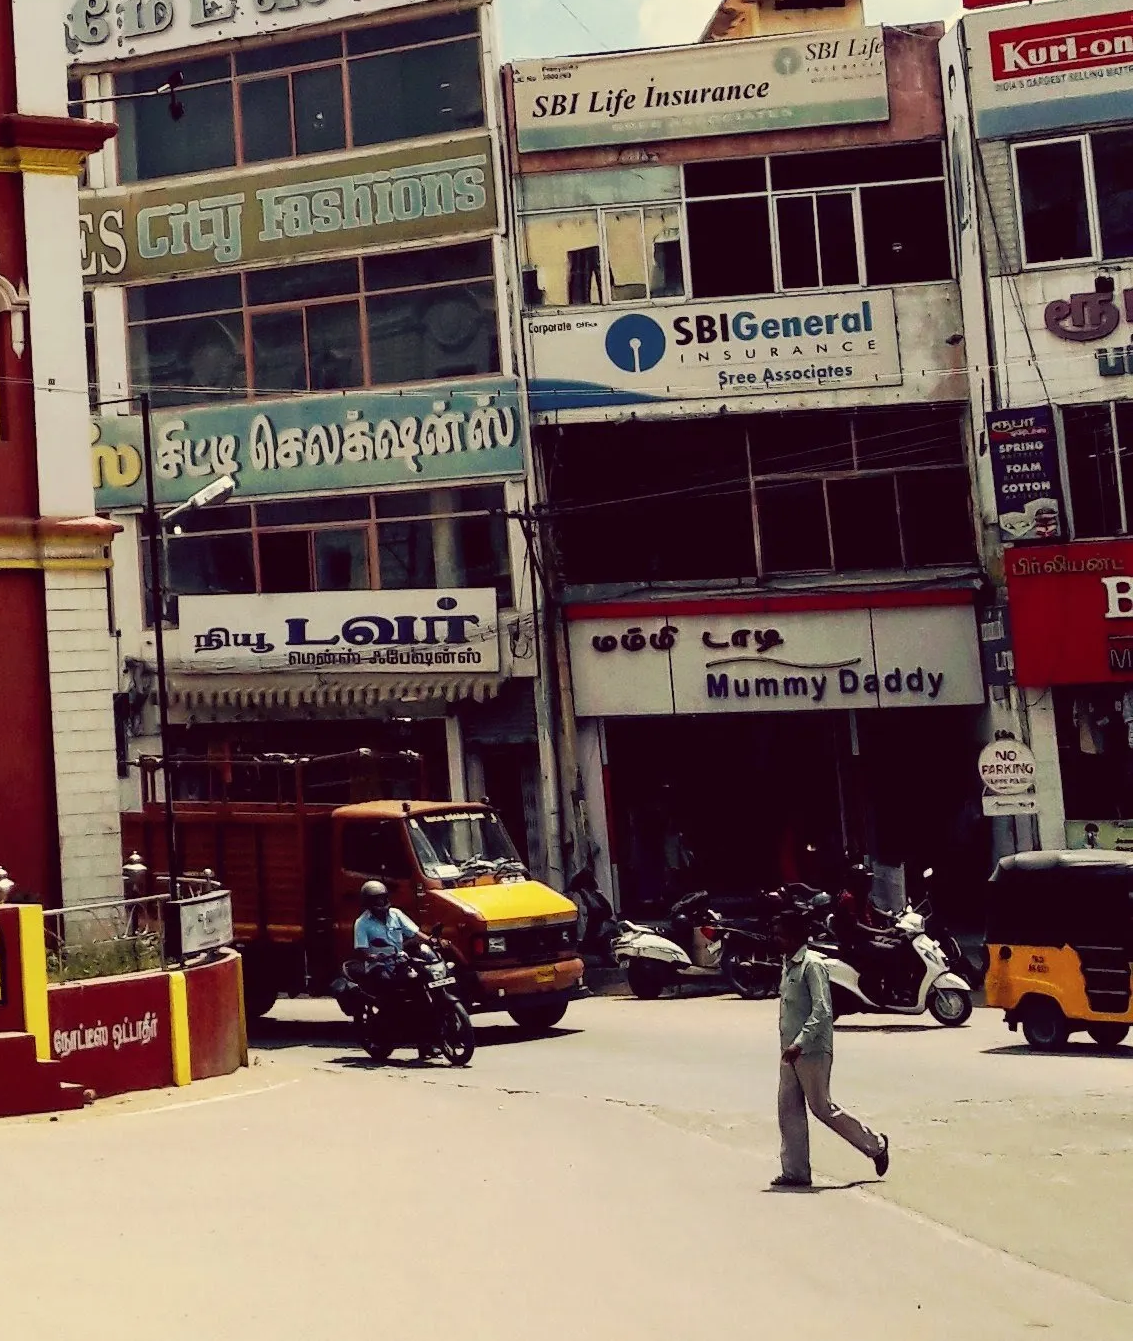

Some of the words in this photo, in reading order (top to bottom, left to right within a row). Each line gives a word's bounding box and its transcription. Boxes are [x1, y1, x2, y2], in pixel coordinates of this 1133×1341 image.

[806, 41, 840, 60] SBI
[847, 37, 883, 61] Life
[999, 33, 1133, 73] Kurl-on
[532, 93, 580, 118] SBI
[588, 87, 637, 118] Life
[136, 194, 245, 262] City
[255, 154, 487, 242] Fashions
[680, 340, 877, 364] INSURANCE
[718, 370, 757, 386] Sree
[763, 364, 854, 383] Associates
[999, 441, 1044, 454] SPRING
[1006, 462, 1042, 474] FOAM
[1002, 481, 1051, 493] COTTON
[193, 628, 276, 654] நியூ
[285, 596, 480, 646] டவர்
[592, 625, 679, 653] மம்மி
[702, 626, 783, 652] டாடி
[707, 673, 827, 701] Mummy
[839, 668, 944, 697] Daddy
[995, 750, 1017, 761] NO
[981, 763, 1034, 775] PARKING
